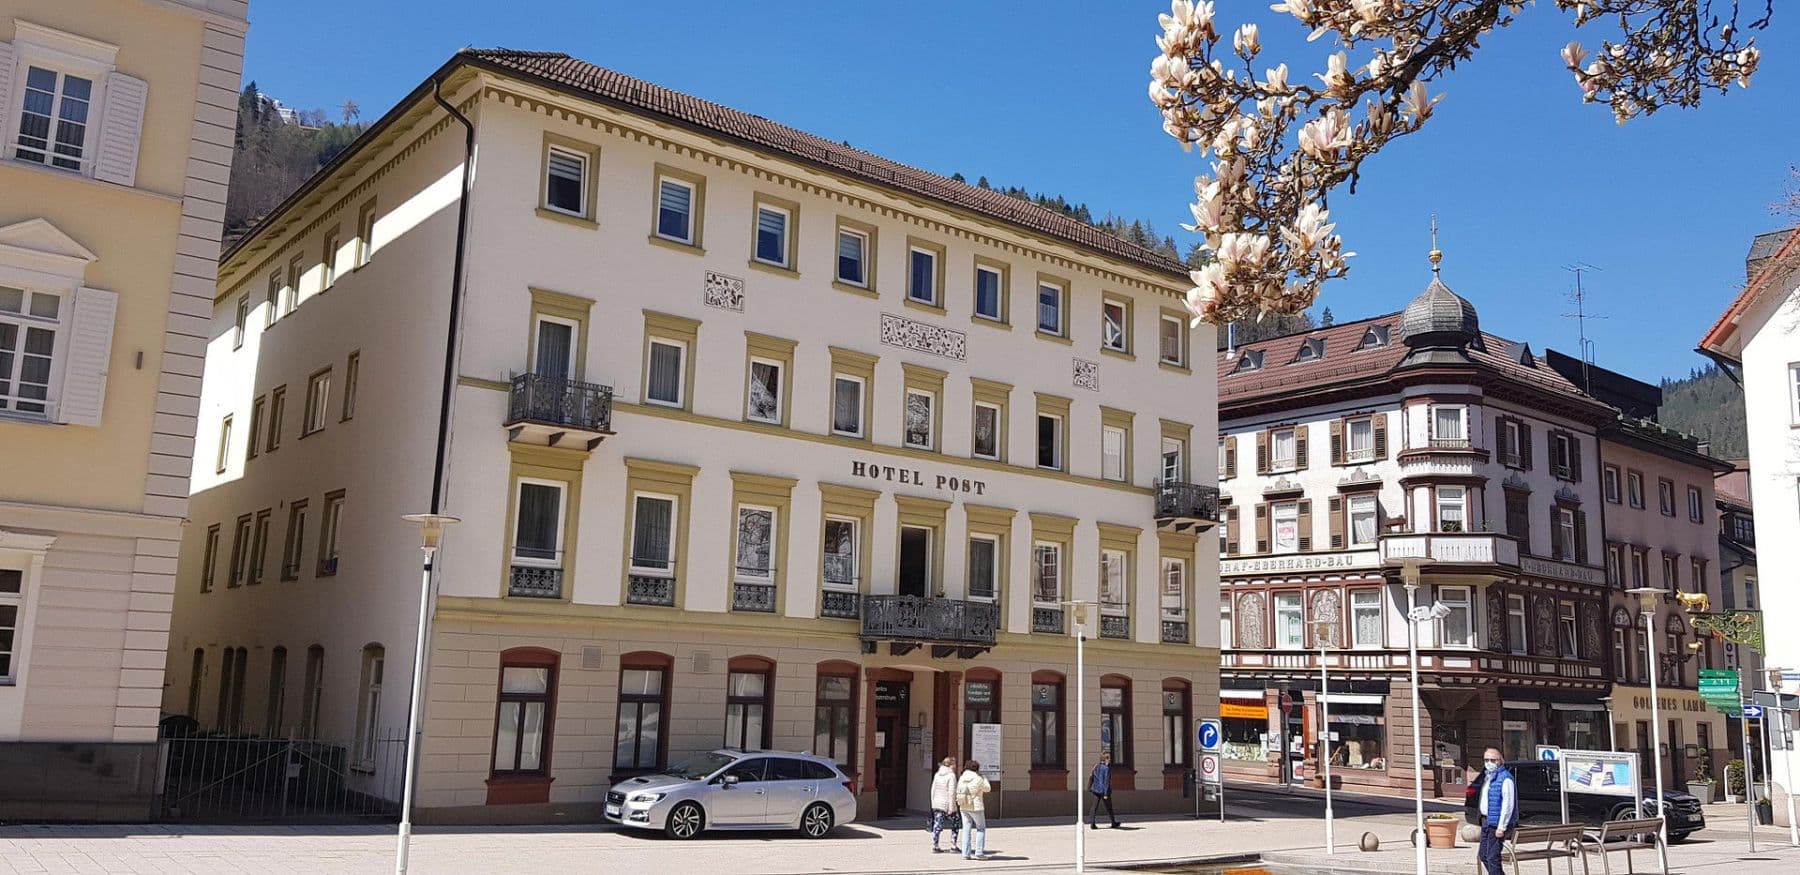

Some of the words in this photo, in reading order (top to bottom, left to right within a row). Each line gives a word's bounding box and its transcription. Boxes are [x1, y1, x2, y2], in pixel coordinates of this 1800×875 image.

[852, 461, 923, 486] HOTEL
[936, 475, 985, 495] POST
[1633, 696, 1677, 711] GOLENES
